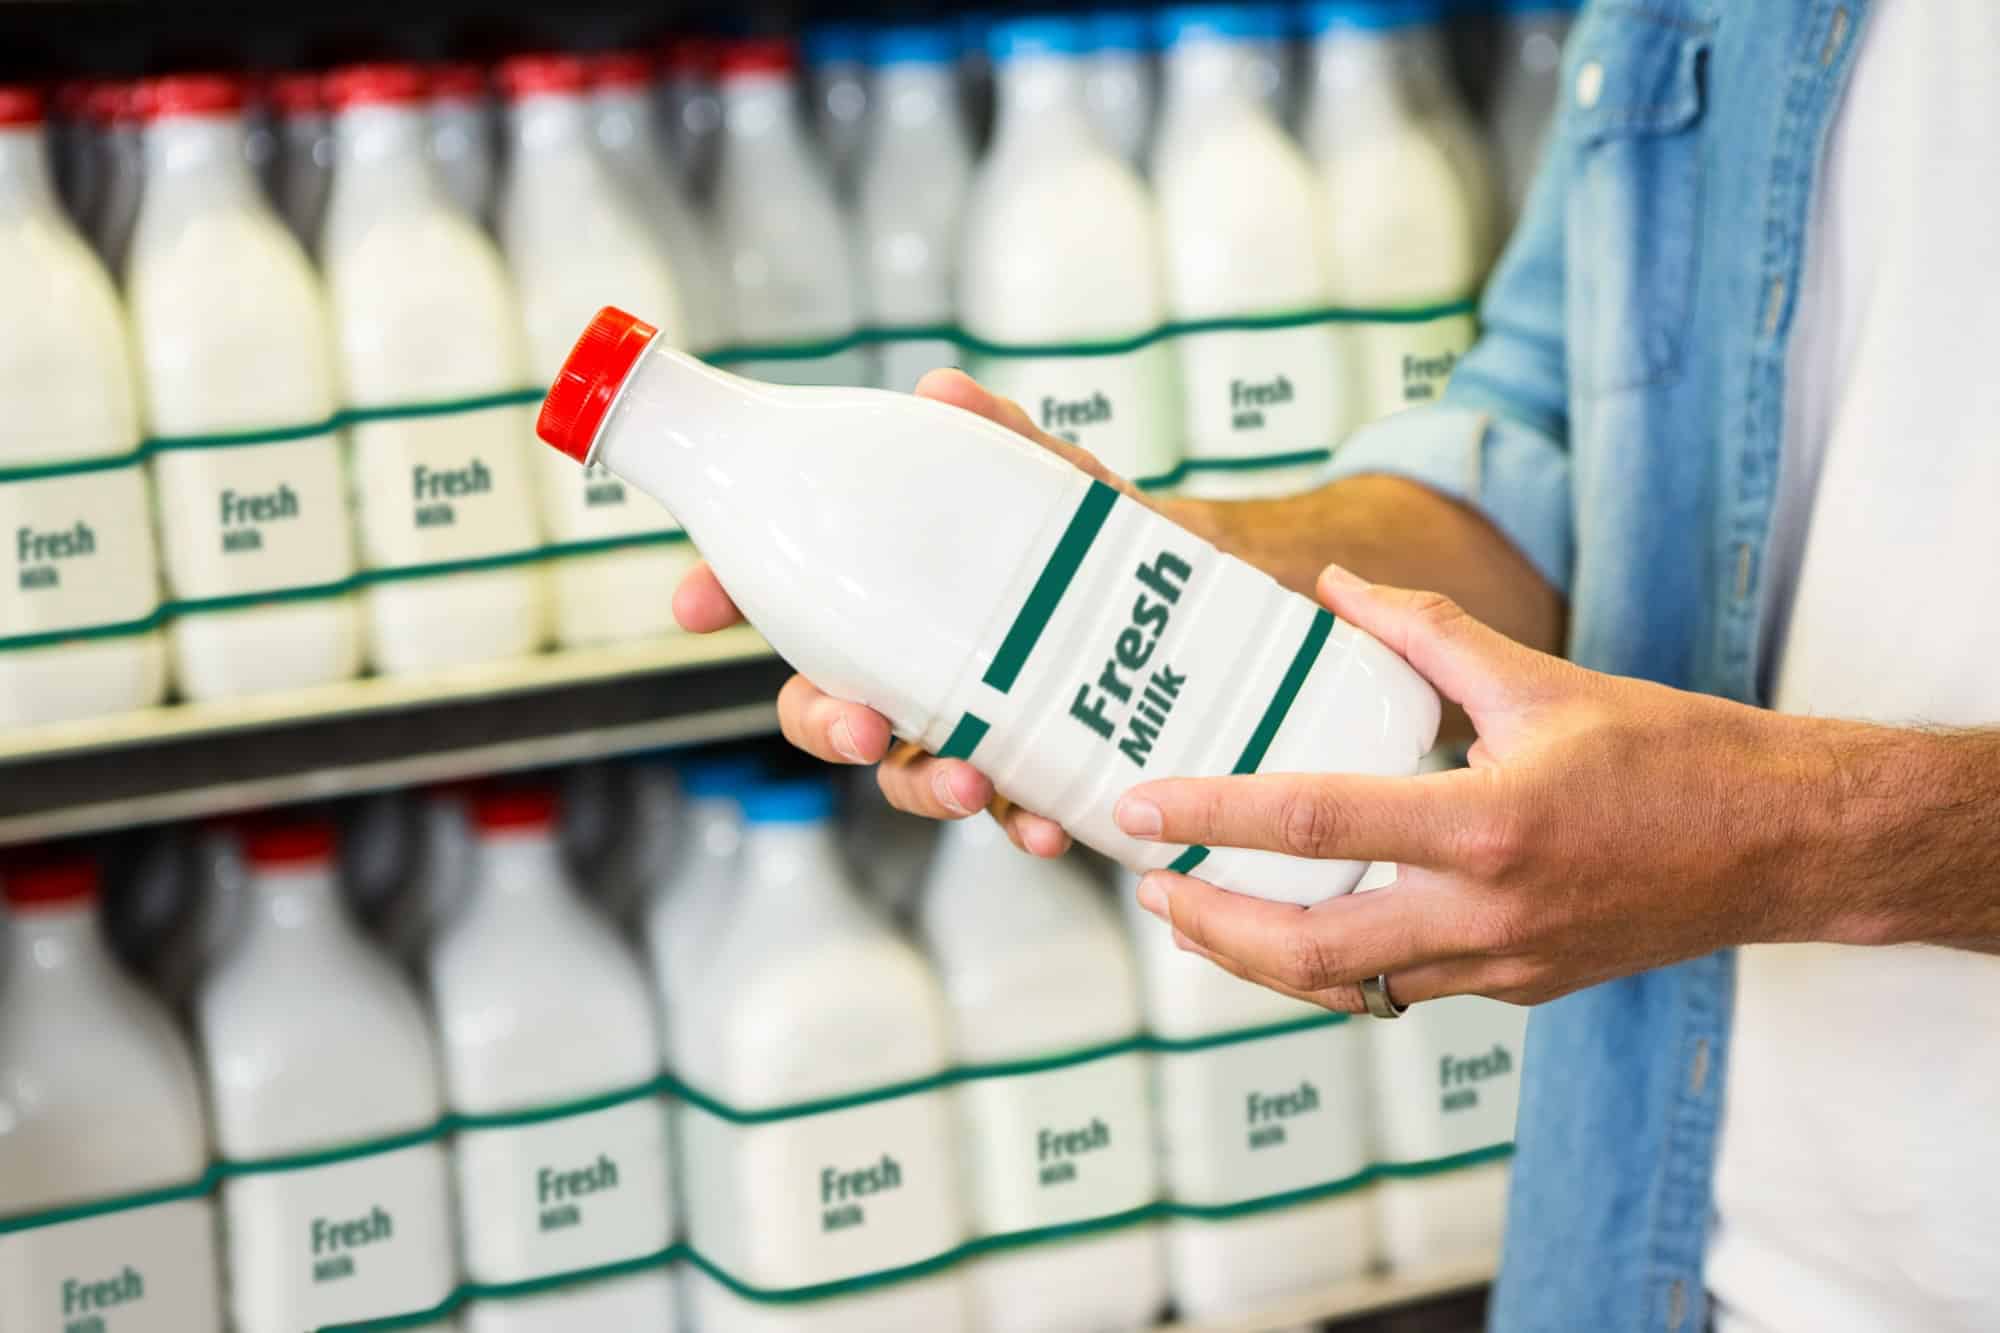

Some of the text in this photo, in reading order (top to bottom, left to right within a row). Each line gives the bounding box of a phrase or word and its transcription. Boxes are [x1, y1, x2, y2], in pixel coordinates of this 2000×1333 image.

[1041, 393, 1112, 427] Fresh
[1231, 375, 1293, 406] Fresh
[413, 458, 492, 499] Fresh
[220, 485, 299, 525] Fresh
[18, 521, 96, 562] Fresh
[1069, 551, 1193, 740] Fresh
[1118, 663, 1187, 768] Milk
[1439, 1045, 1511, 1088] Fresh
[1246, 1082, 1320, 1125] Fresh
[1037, 1117, 1110, 1160] Fresh
[537, 1155, 618, 1202] Fresh
[820, 1154, 901, 1203] Fresh
[311, 1206, 392, 1255] Fresh
[62, 1266, 144, 1315] Fresh
